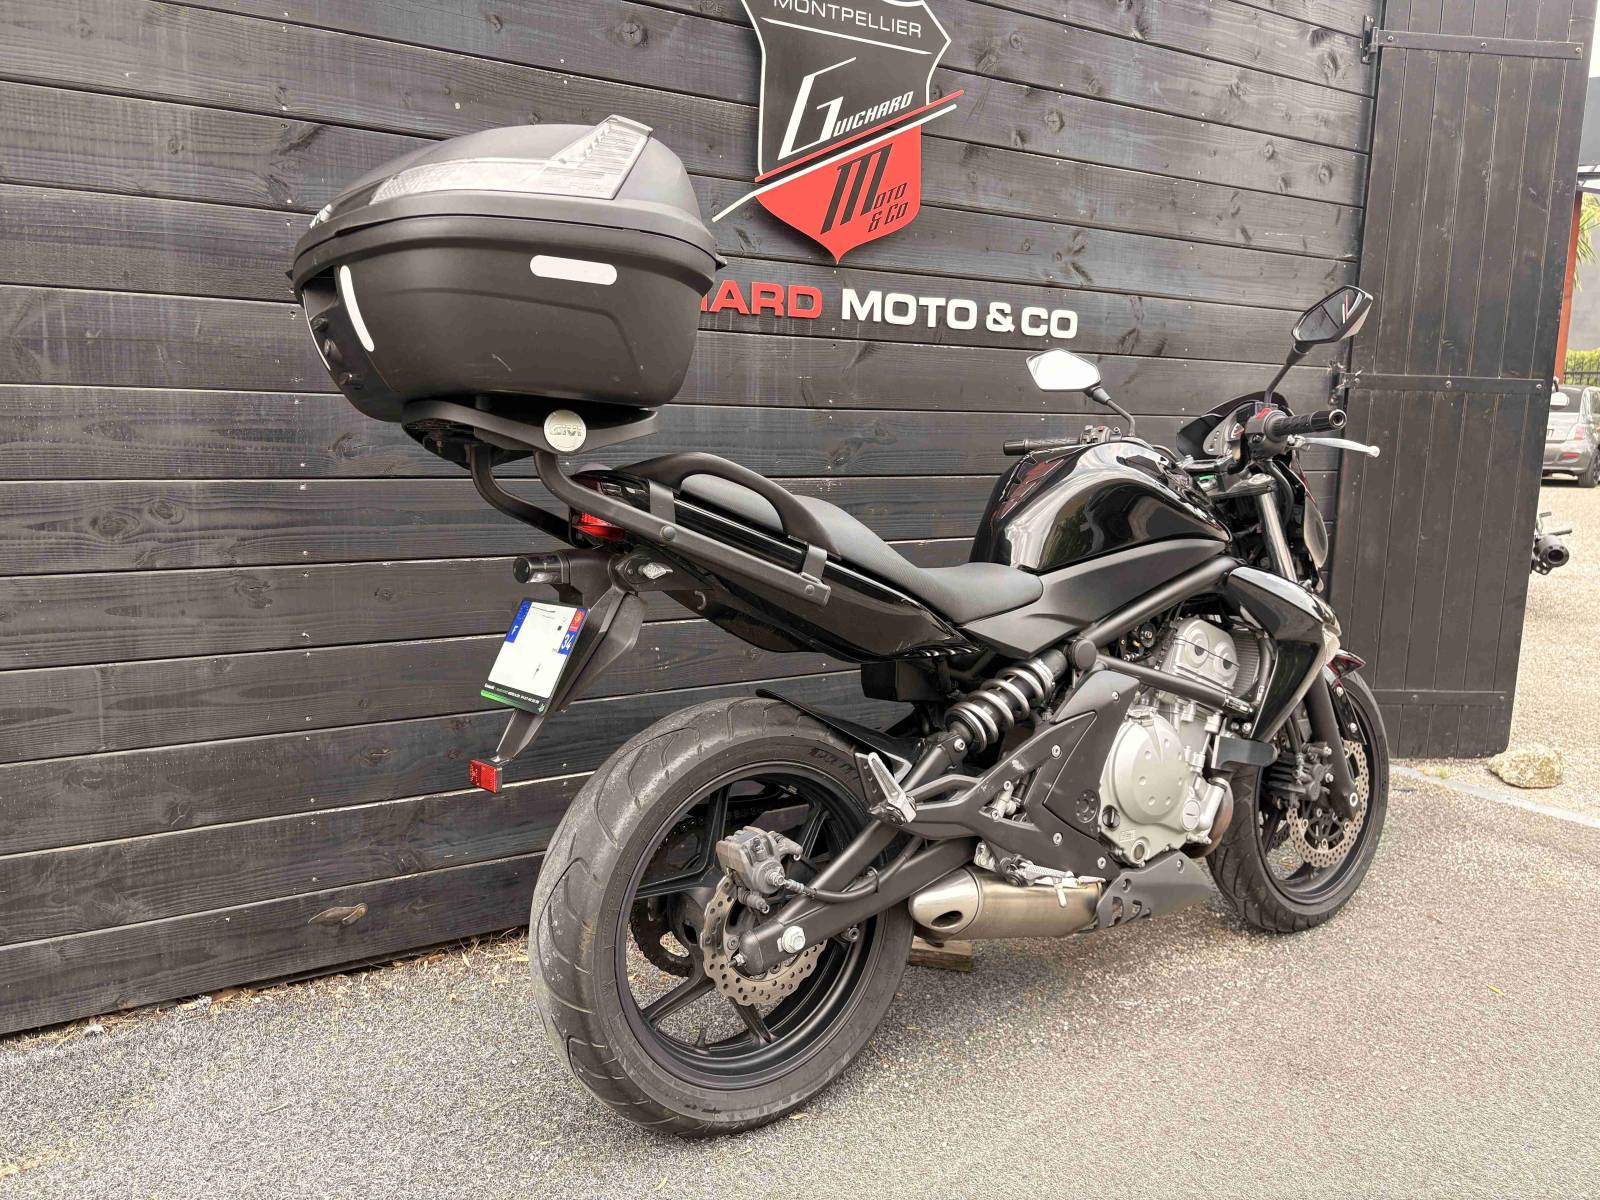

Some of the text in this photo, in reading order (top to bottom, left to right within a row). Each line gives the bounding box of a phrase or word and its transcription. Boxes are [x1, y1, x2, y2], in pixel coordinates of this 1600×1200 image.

[774, 0, 921, 38] MONTPELLIER
[777, 57, 914, 161] GUICHARD
[820, 143, 908, 235] MOTO
[868, 201, 909, 233] & CO
